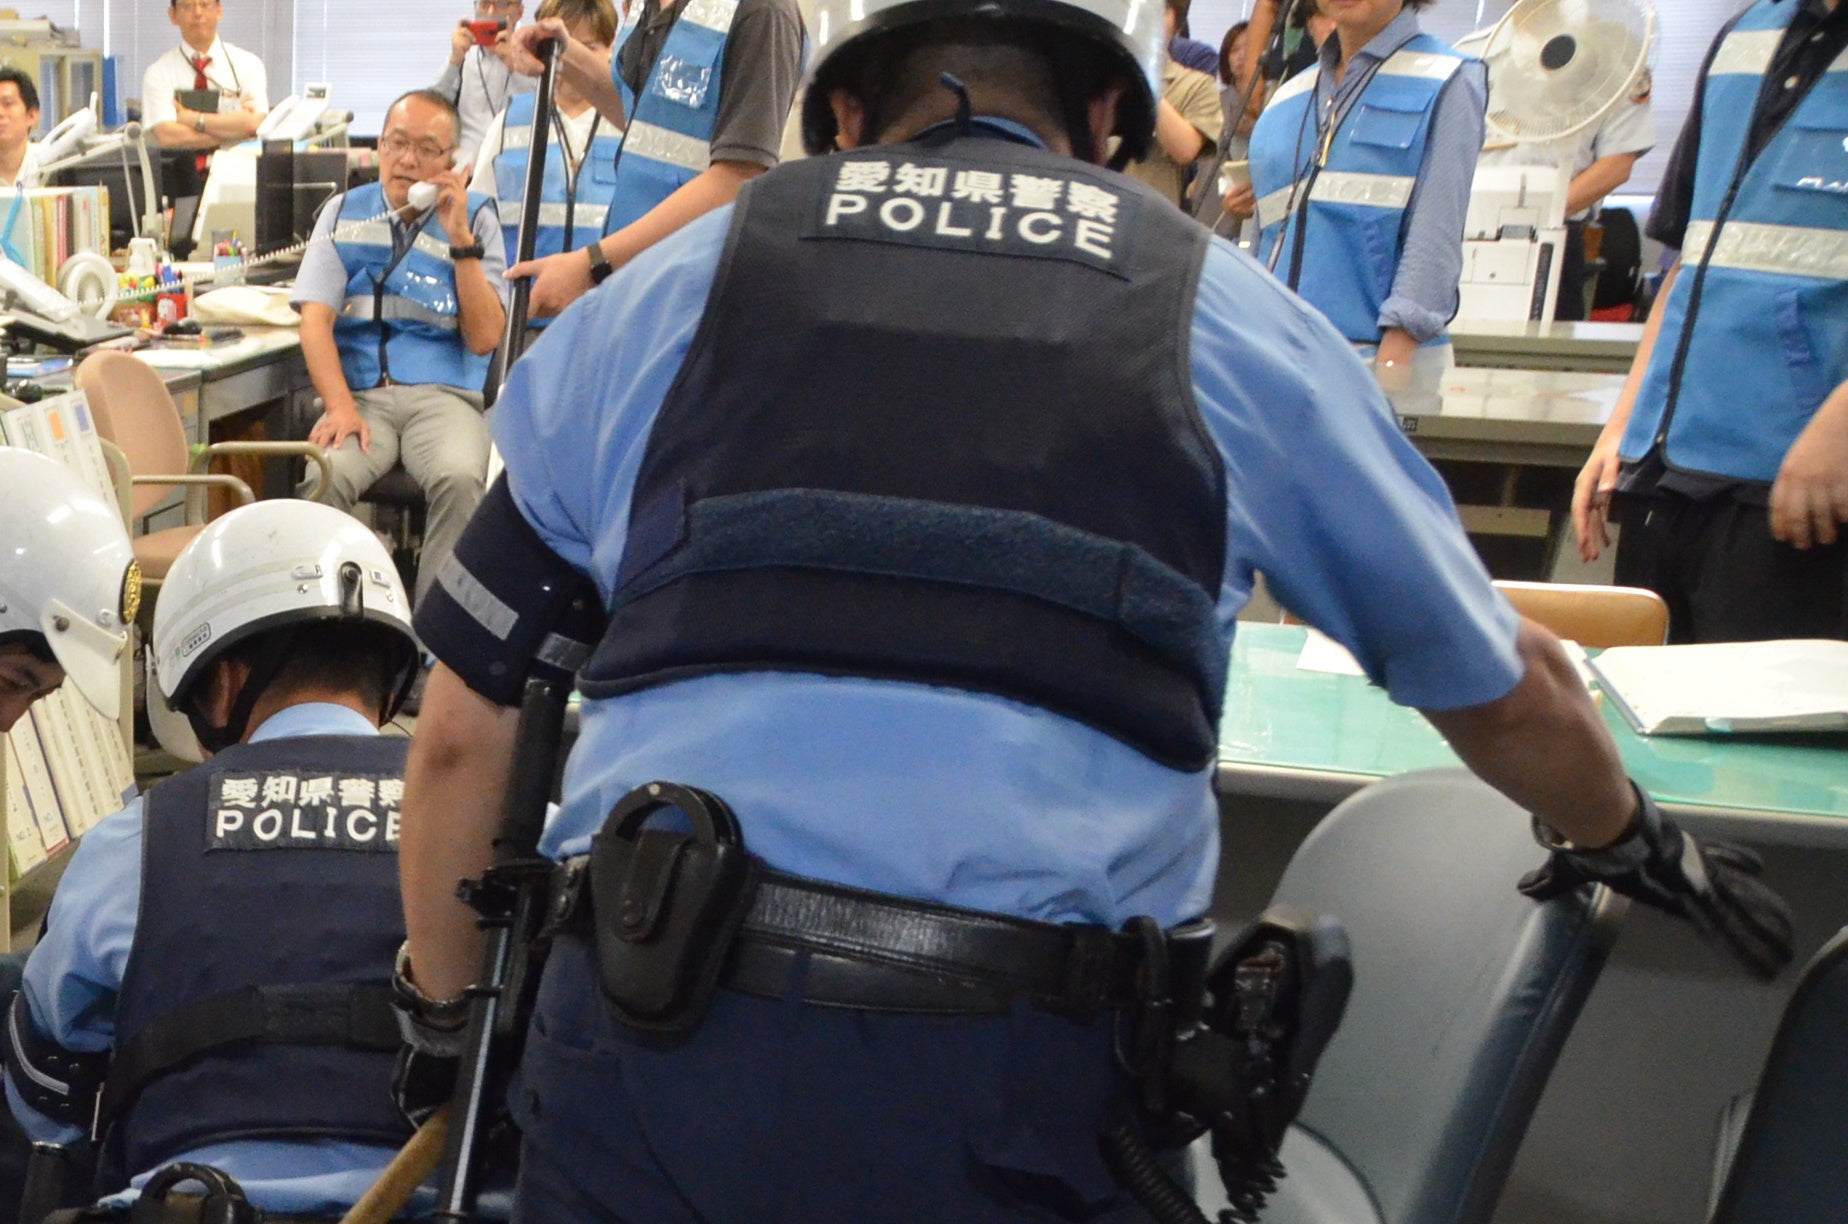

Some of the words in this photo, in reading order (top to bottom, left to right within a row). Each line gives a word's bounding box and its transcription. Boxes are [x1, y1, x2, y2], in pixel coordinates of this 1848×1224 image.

[835, 160, 1119, 224] 愛知県警察
[825, 193, 1115, 259] POLICE
[221, 776, 405, 809] 愛知県警察
[215, 806, 401, 842] POLICE
